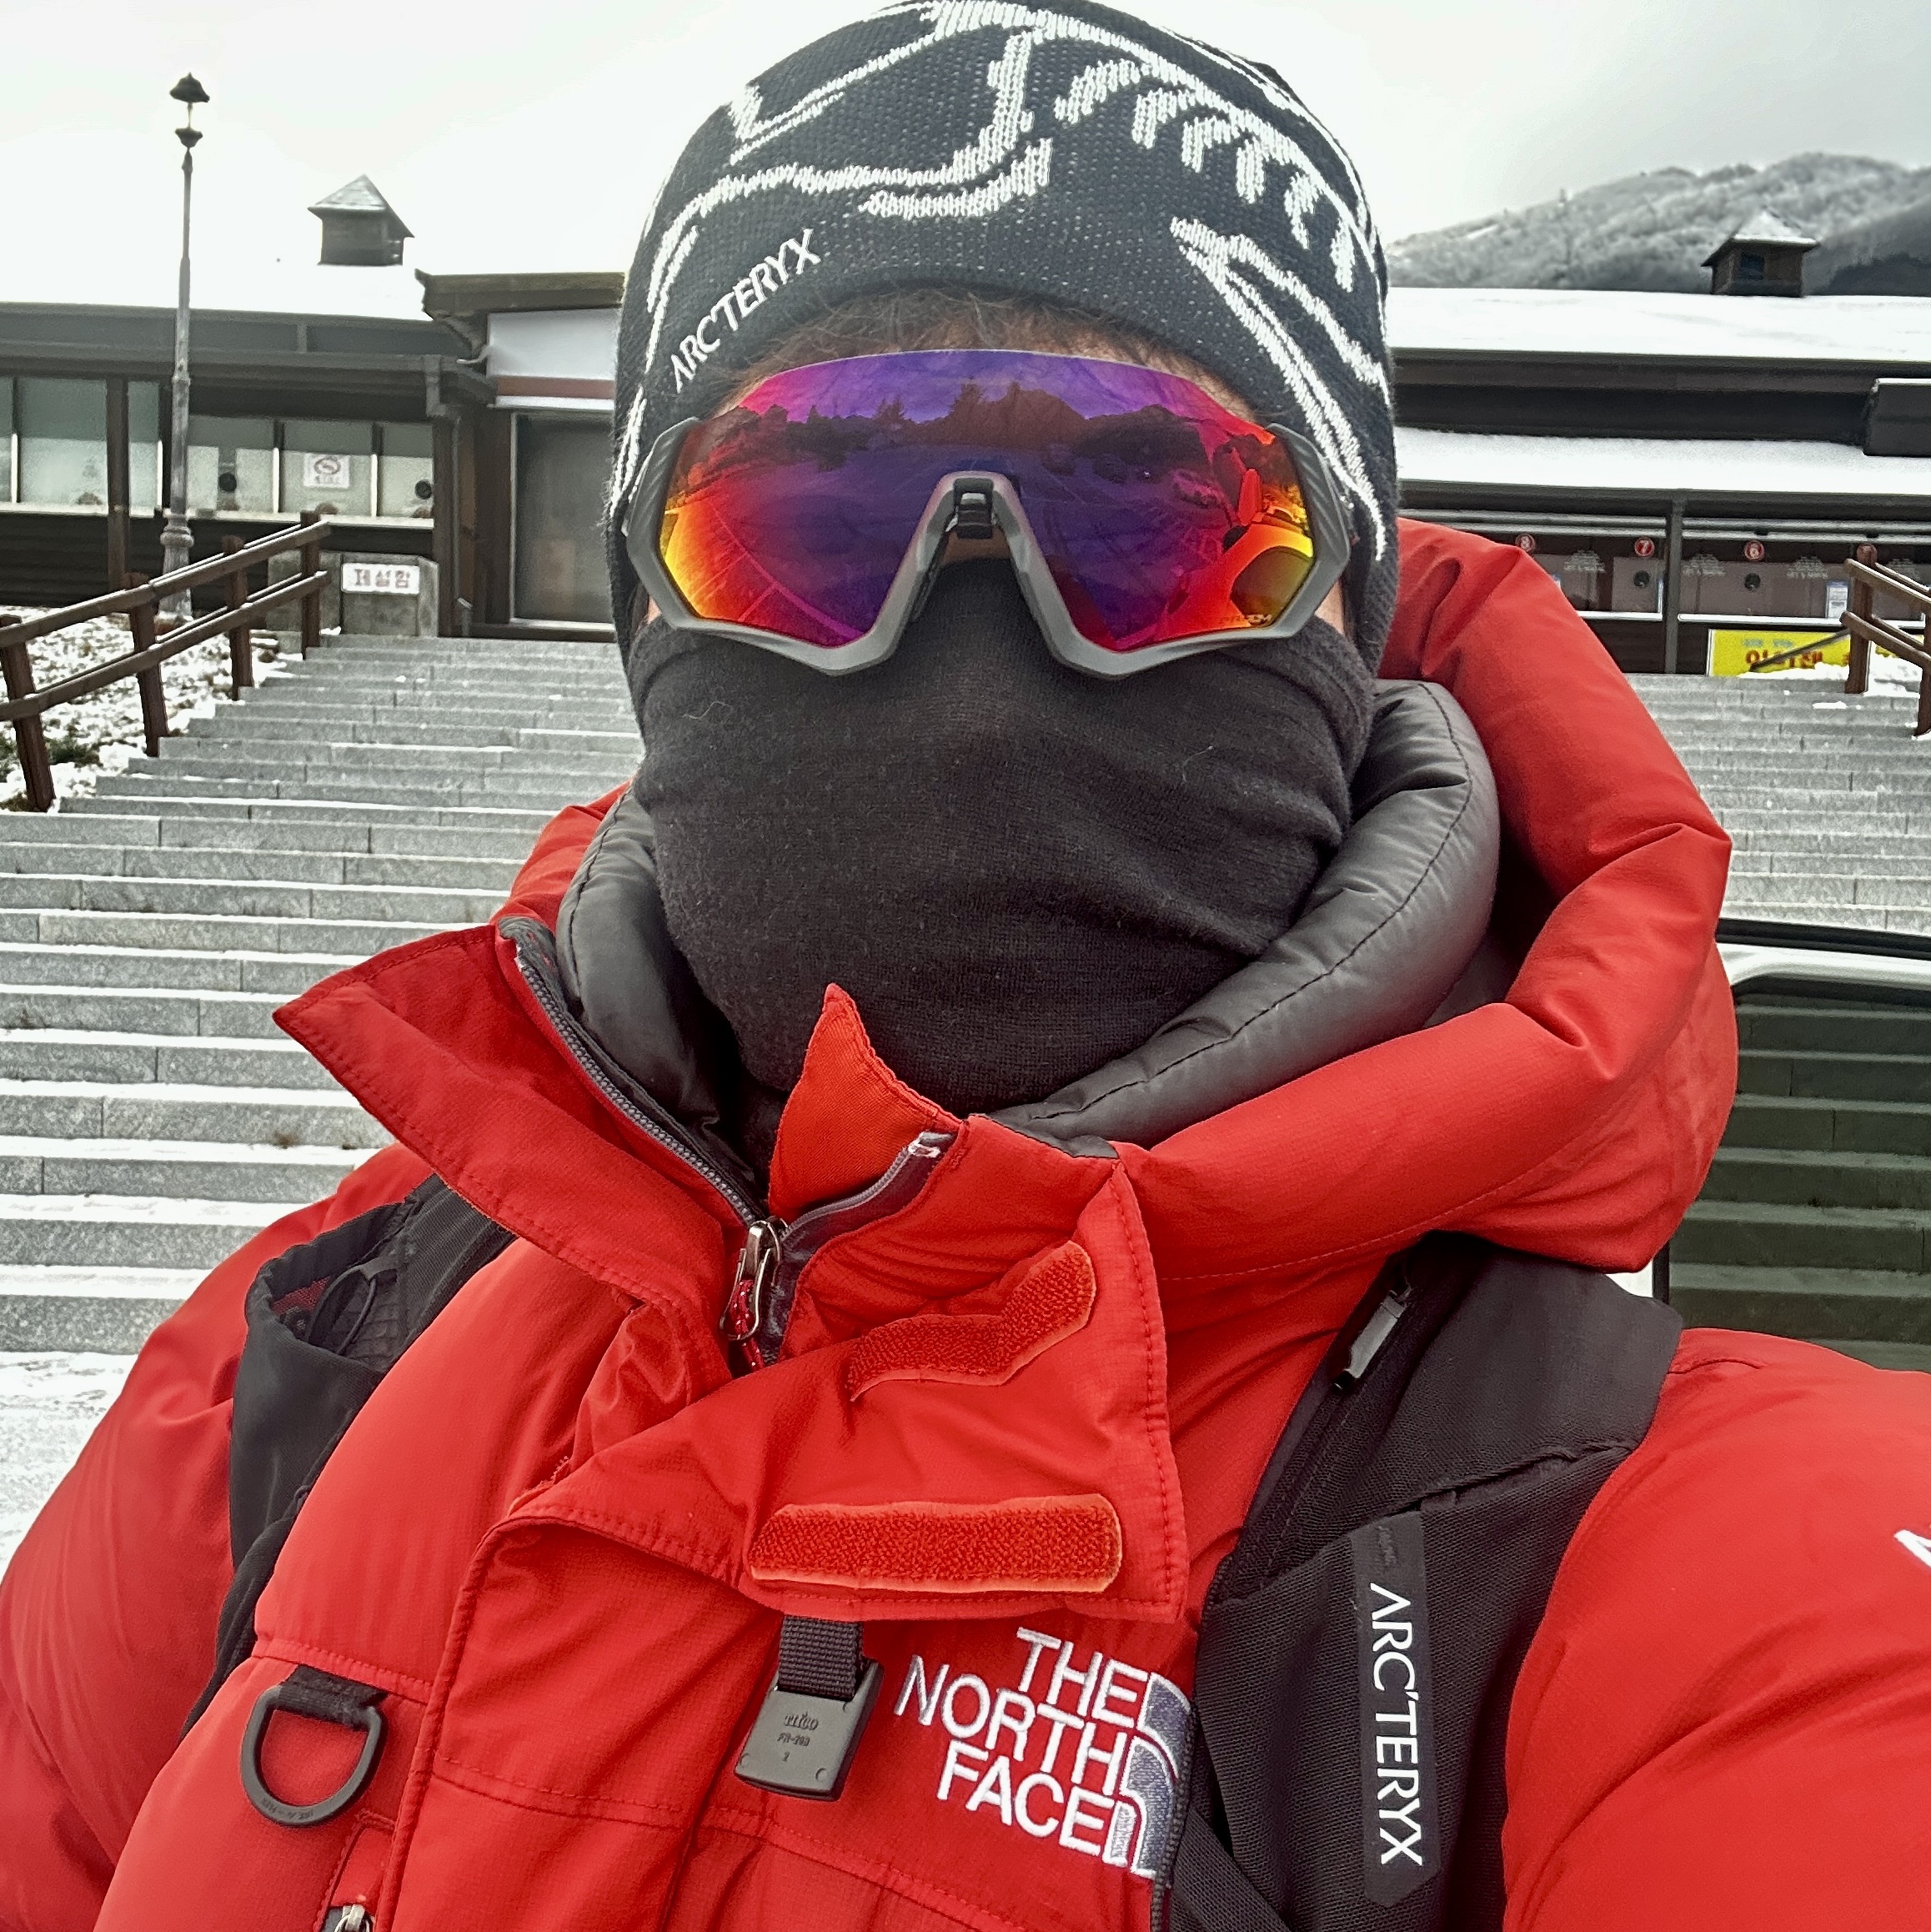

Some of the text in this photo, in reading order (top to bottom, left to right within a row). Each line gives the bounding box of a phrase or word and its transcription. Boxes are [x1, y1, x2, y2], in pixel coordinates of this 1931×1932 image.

[354, 568, 411, 589] 제설함
[1639, 539, 1649, 555] 7
[894, 1653, 1127, 1796] NORTH
[1016, 1626, 1148, 1729] THE
[1370, 1582, 1422, 1866] ARC'TERYX
[936, 1739, 1114, 1856] FACE
